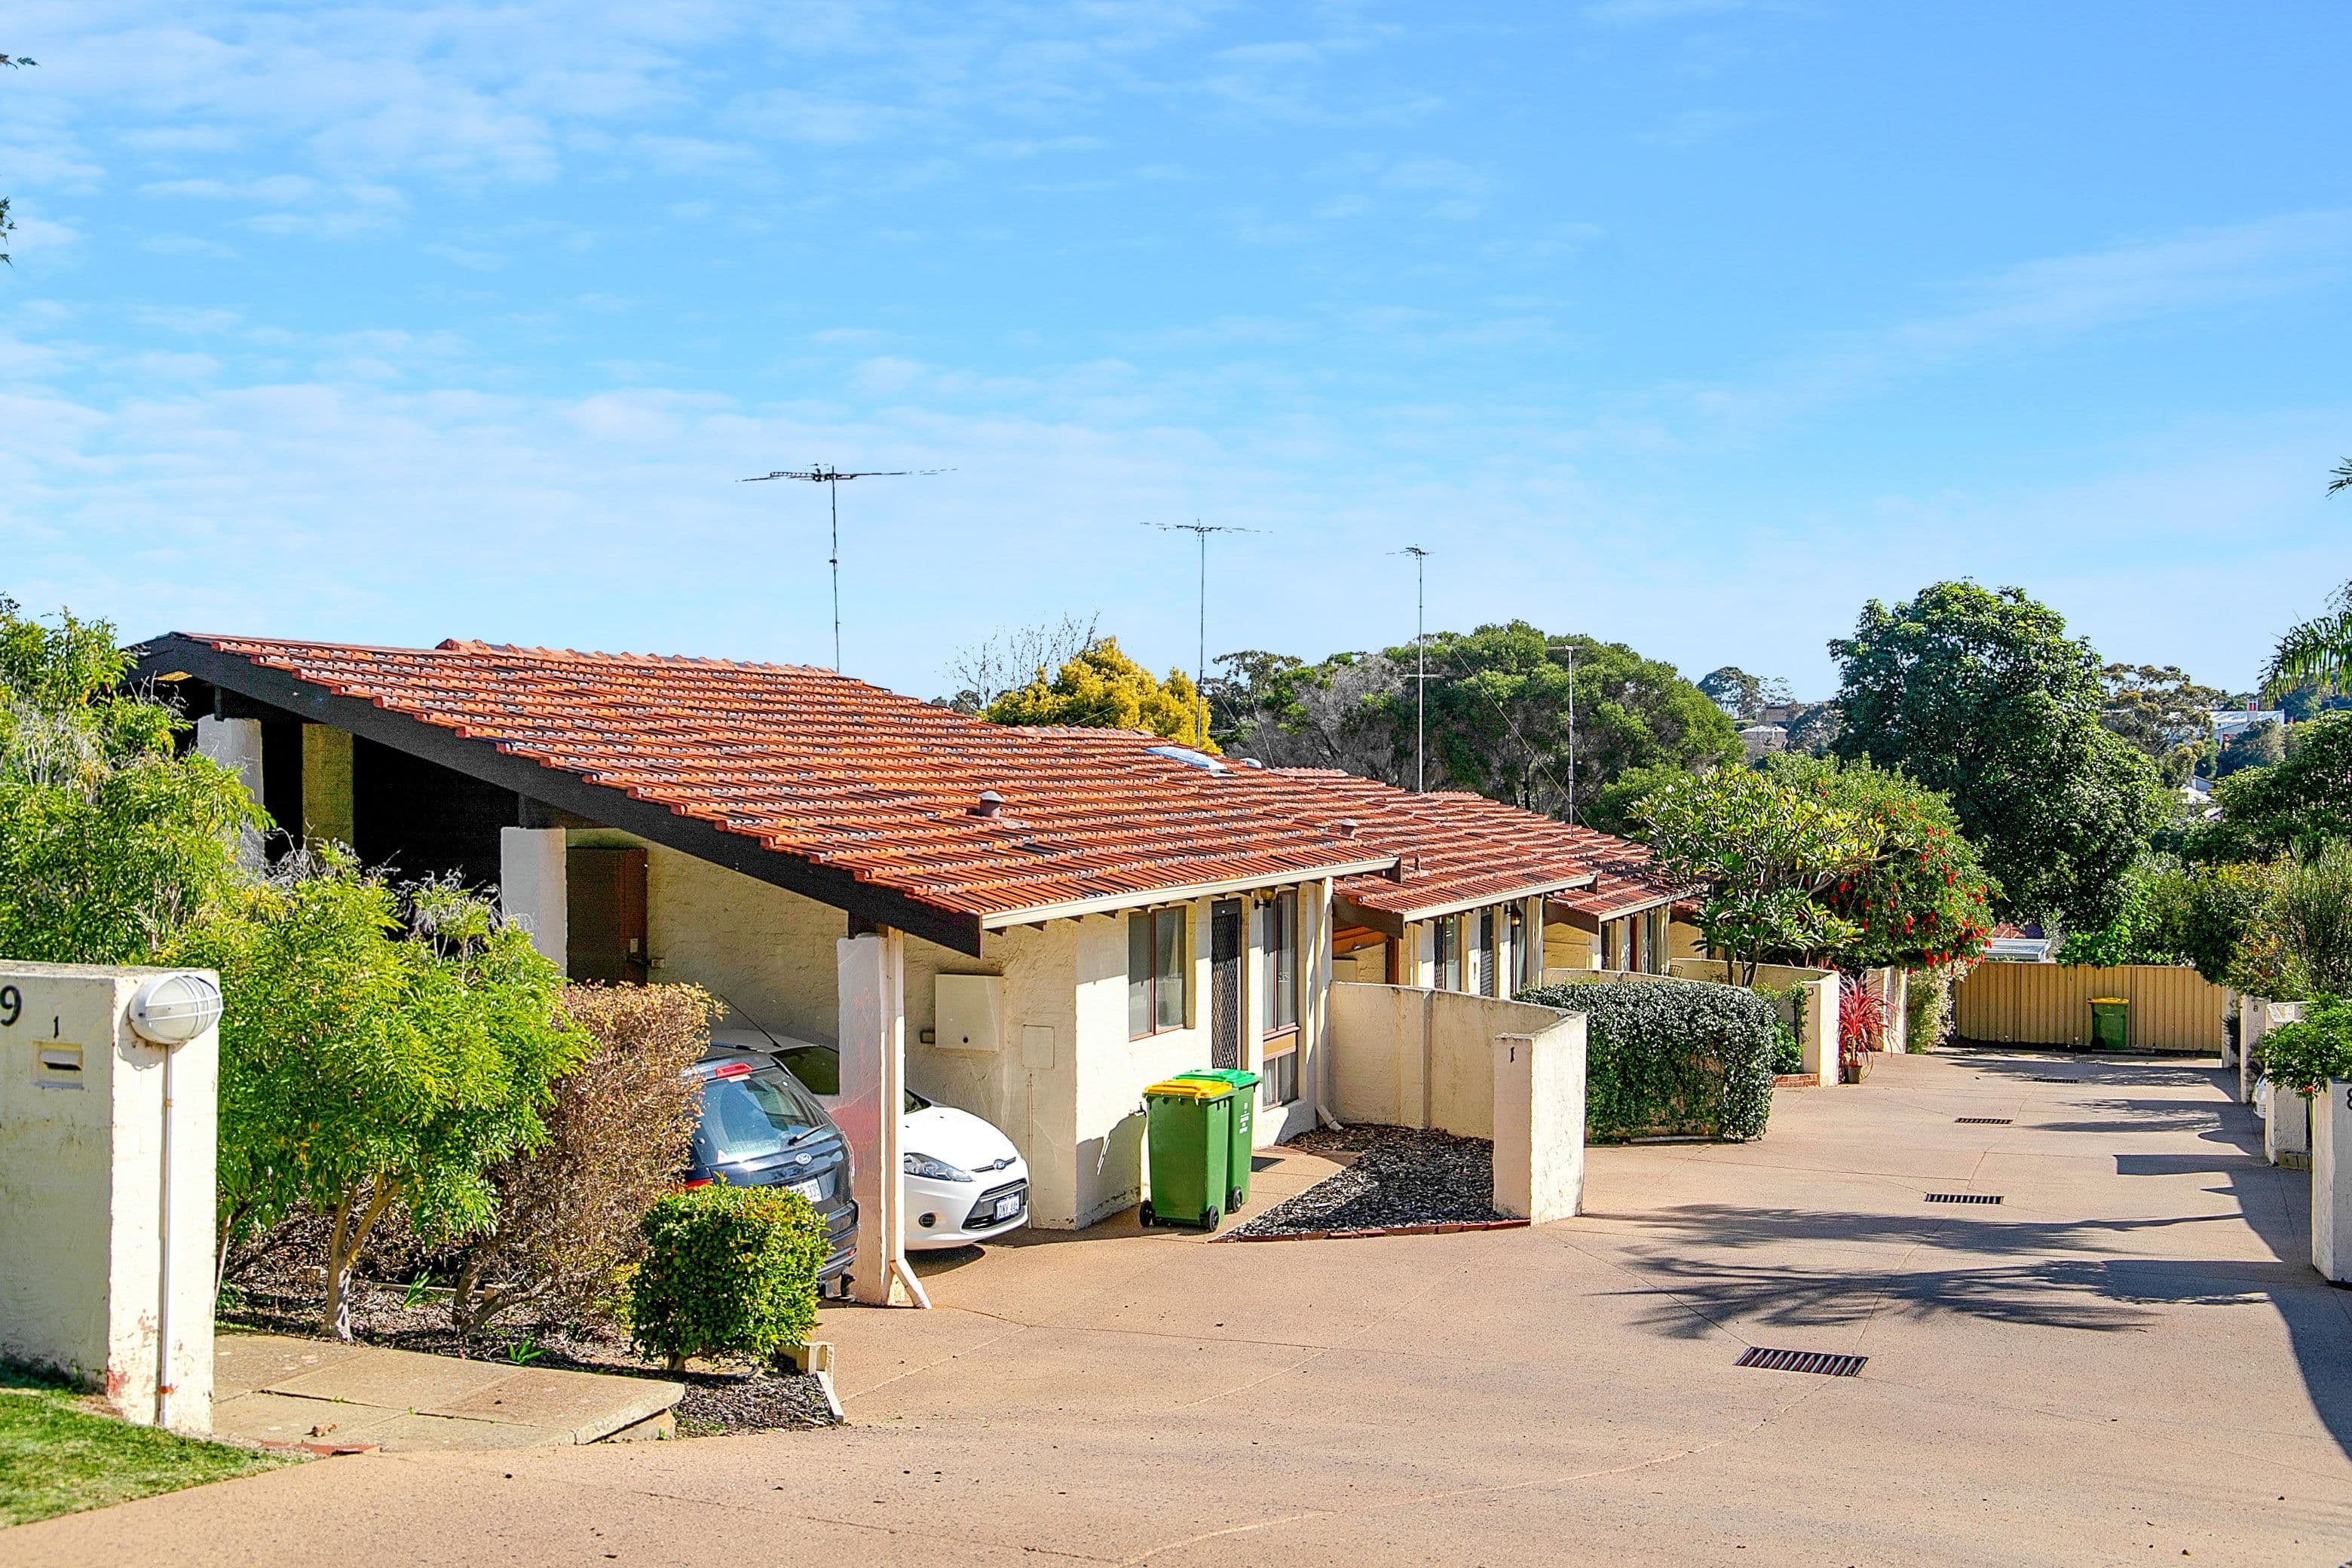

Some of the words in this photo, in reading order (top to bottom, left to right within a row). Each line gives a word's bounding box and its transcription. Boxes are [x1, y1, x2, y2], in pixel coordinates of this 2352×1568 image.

[0, 985, 22, 1026] 9
[54, 1015, 60, 1038] 1
[1510, 1046, 1515, 1063] 1
